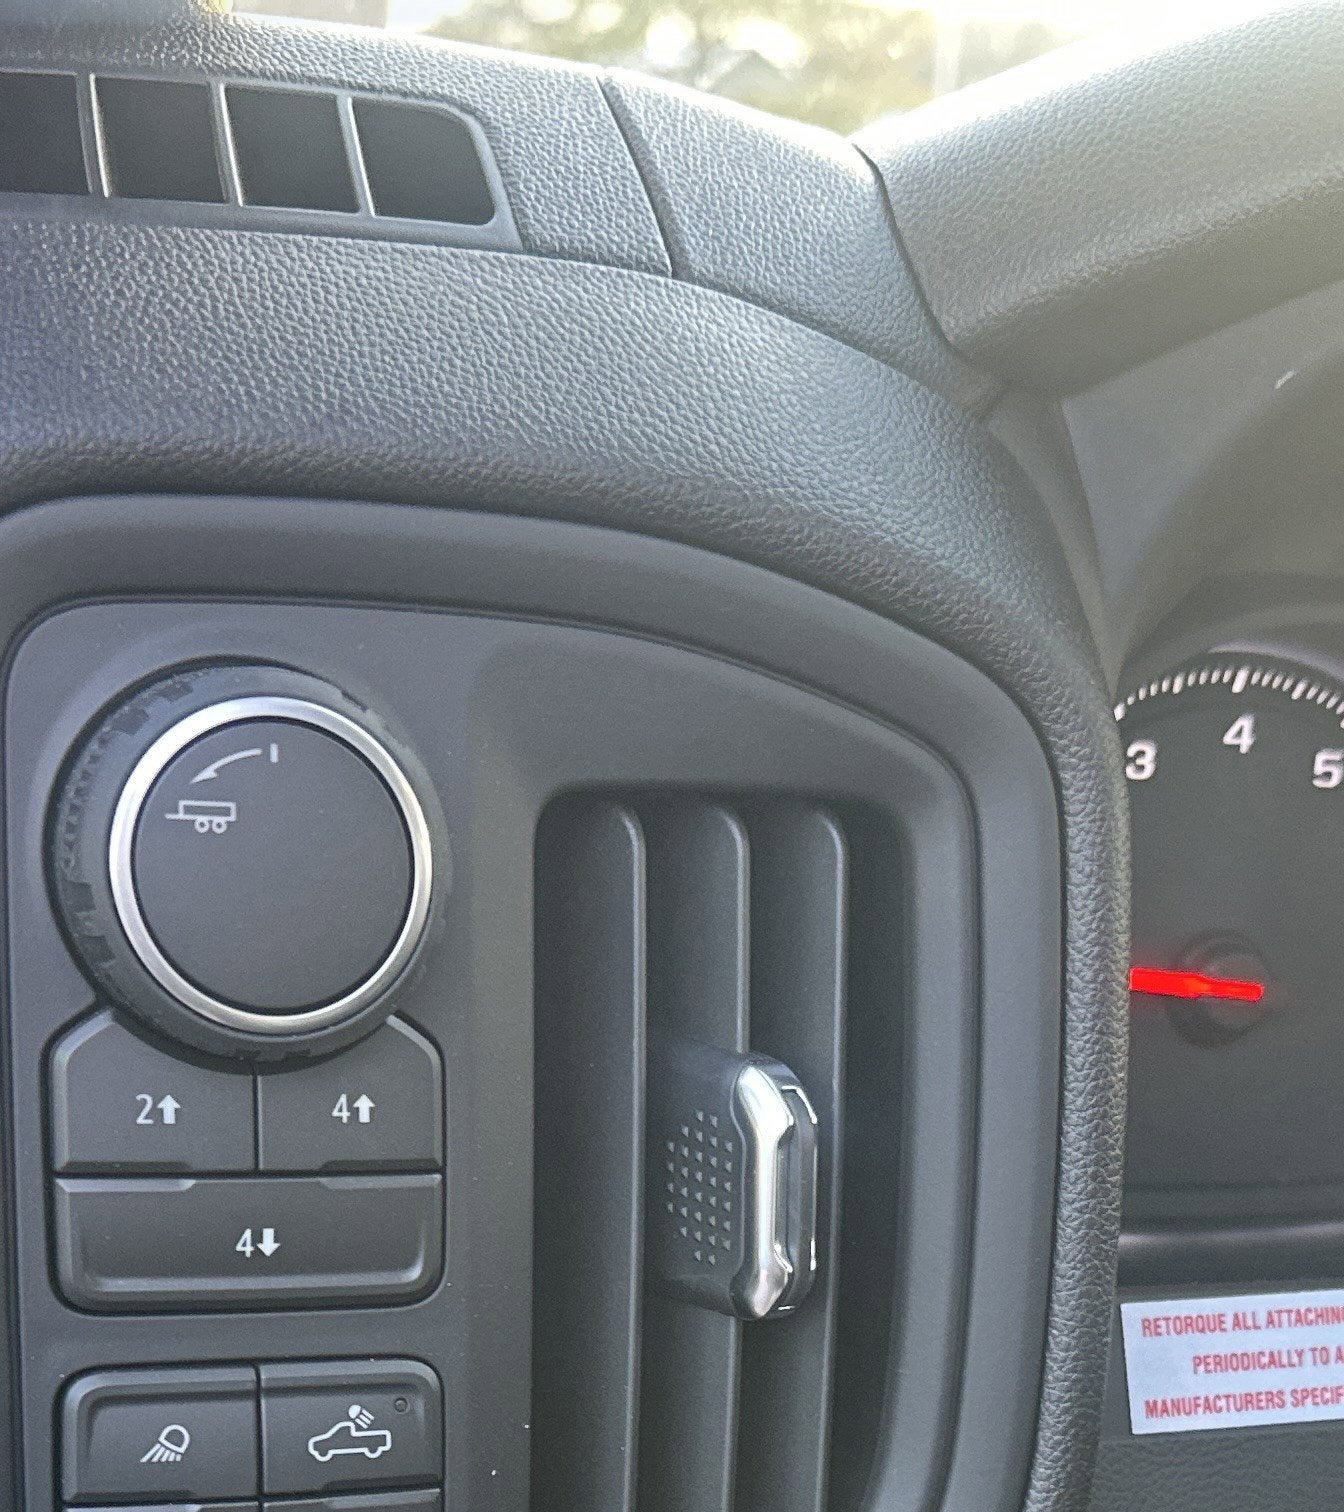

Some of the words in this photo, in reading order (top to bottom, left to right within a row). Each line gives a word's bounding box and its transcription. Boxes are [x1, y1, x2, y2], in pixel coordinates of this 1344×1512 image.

[1223, 713, 1256, 754] 4
[1125, 739, 1158, 781] 3
[1141, 1313, 1227, 1337] RETORQUE
[1232, 1311, 1261, 1332] ALL
[1192, 1347, 1305, 1374] PERIODICALLY
[1309, 1346, 1330, 1366] TO
[1144, 1389, 1285, 1419] MANUFACTURERS
